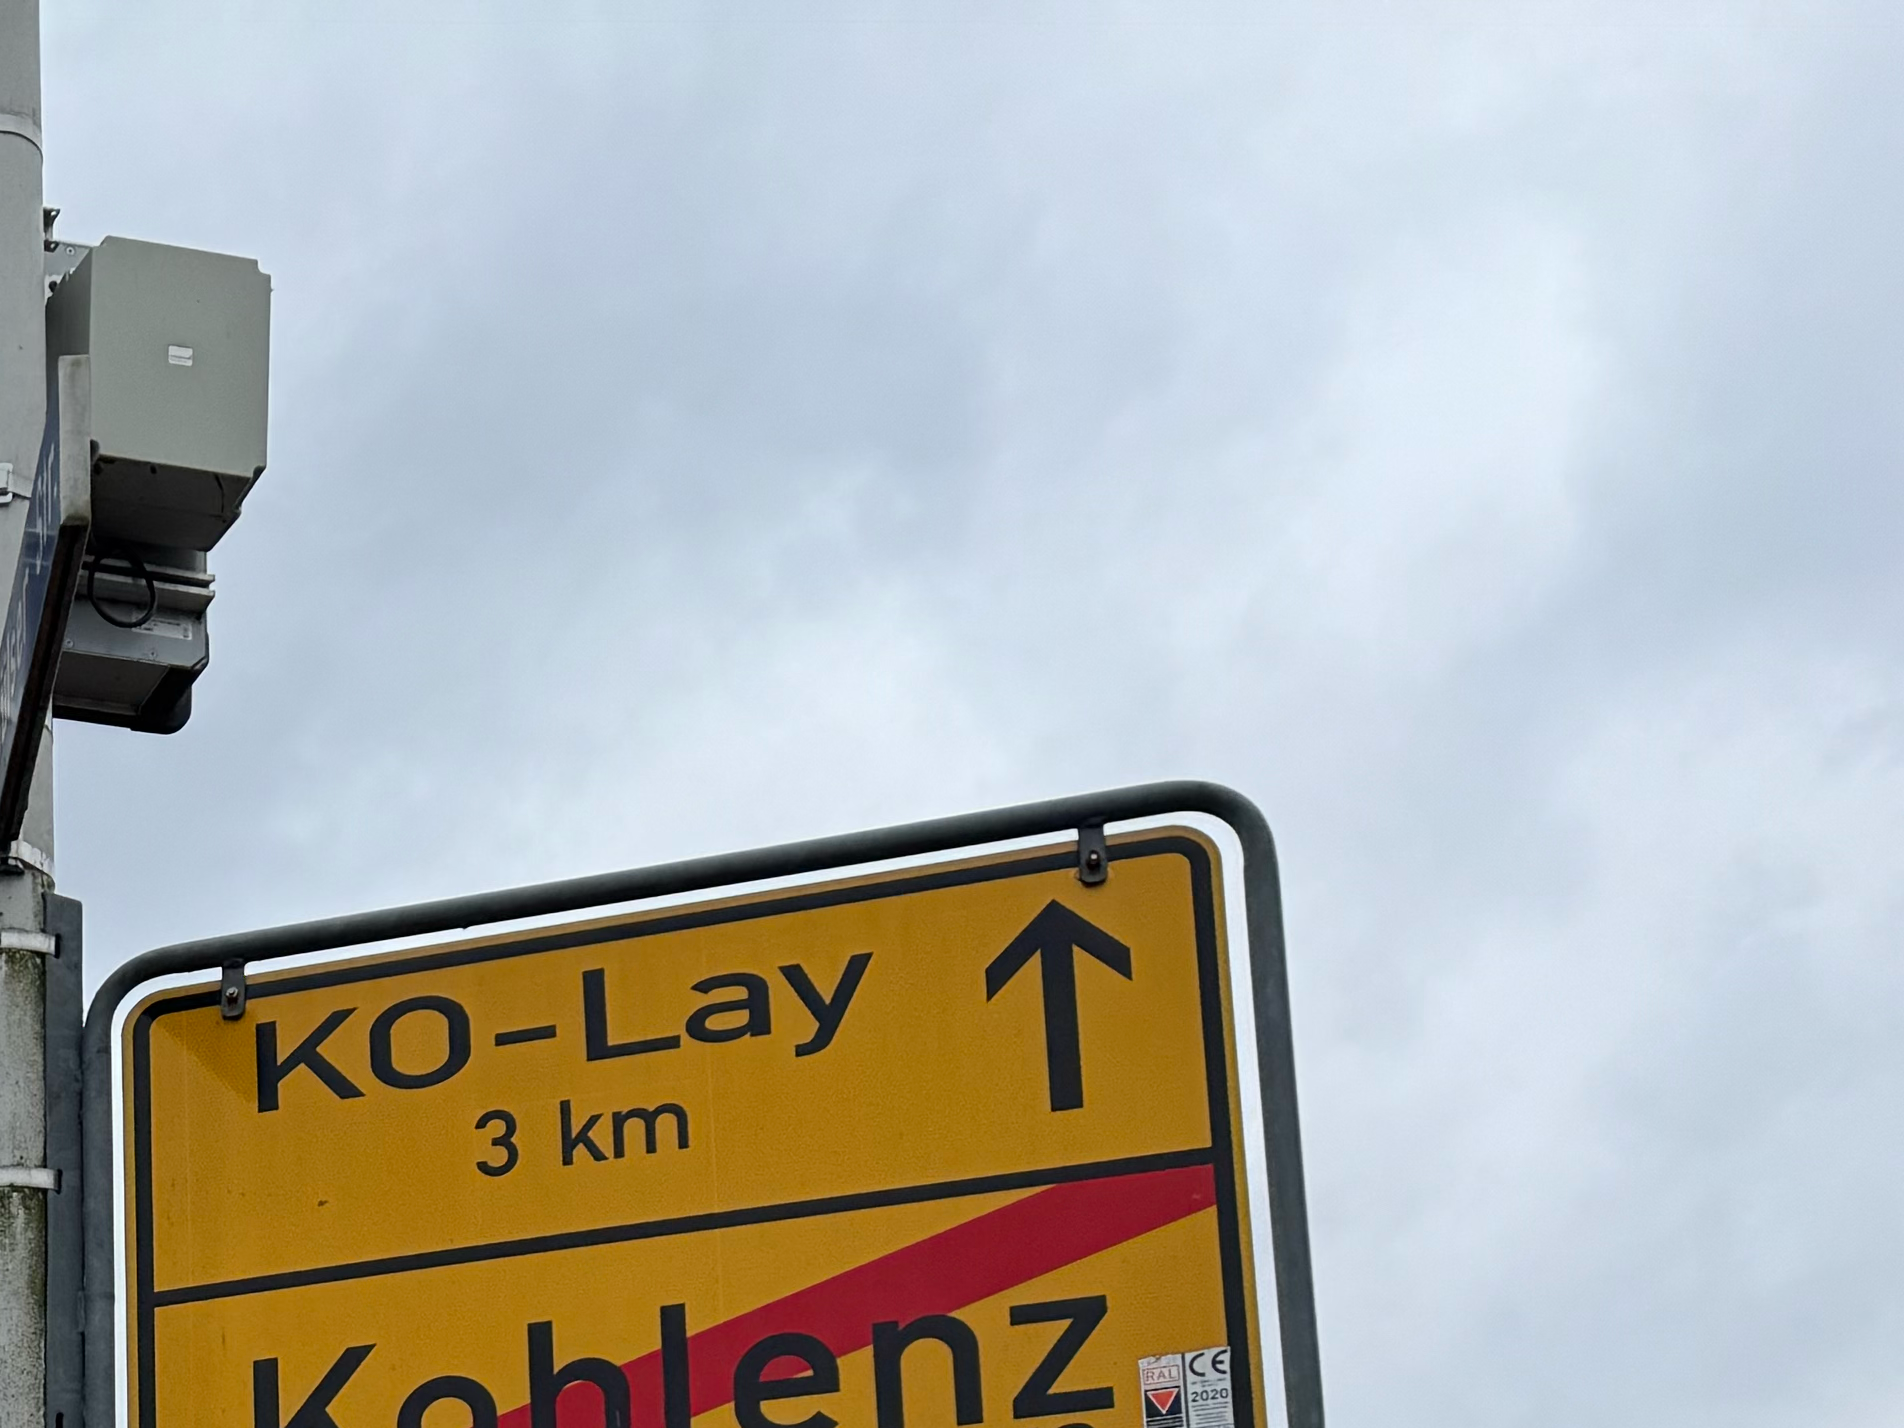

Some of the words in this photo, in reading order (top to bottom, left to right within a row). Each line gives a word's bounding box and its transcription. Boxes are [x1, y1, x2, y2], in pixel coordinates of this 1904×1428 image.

[35, 442, 57, 575] Str.
[255, 952, 874, 1113] KO-Lay
[474, 1110, 519, 1177] 3
[560, 1100, 690, 1167] km
[1145, 1369, 1177, 1382] RAL
[1190, 1387, 1229, 1403] 2020
